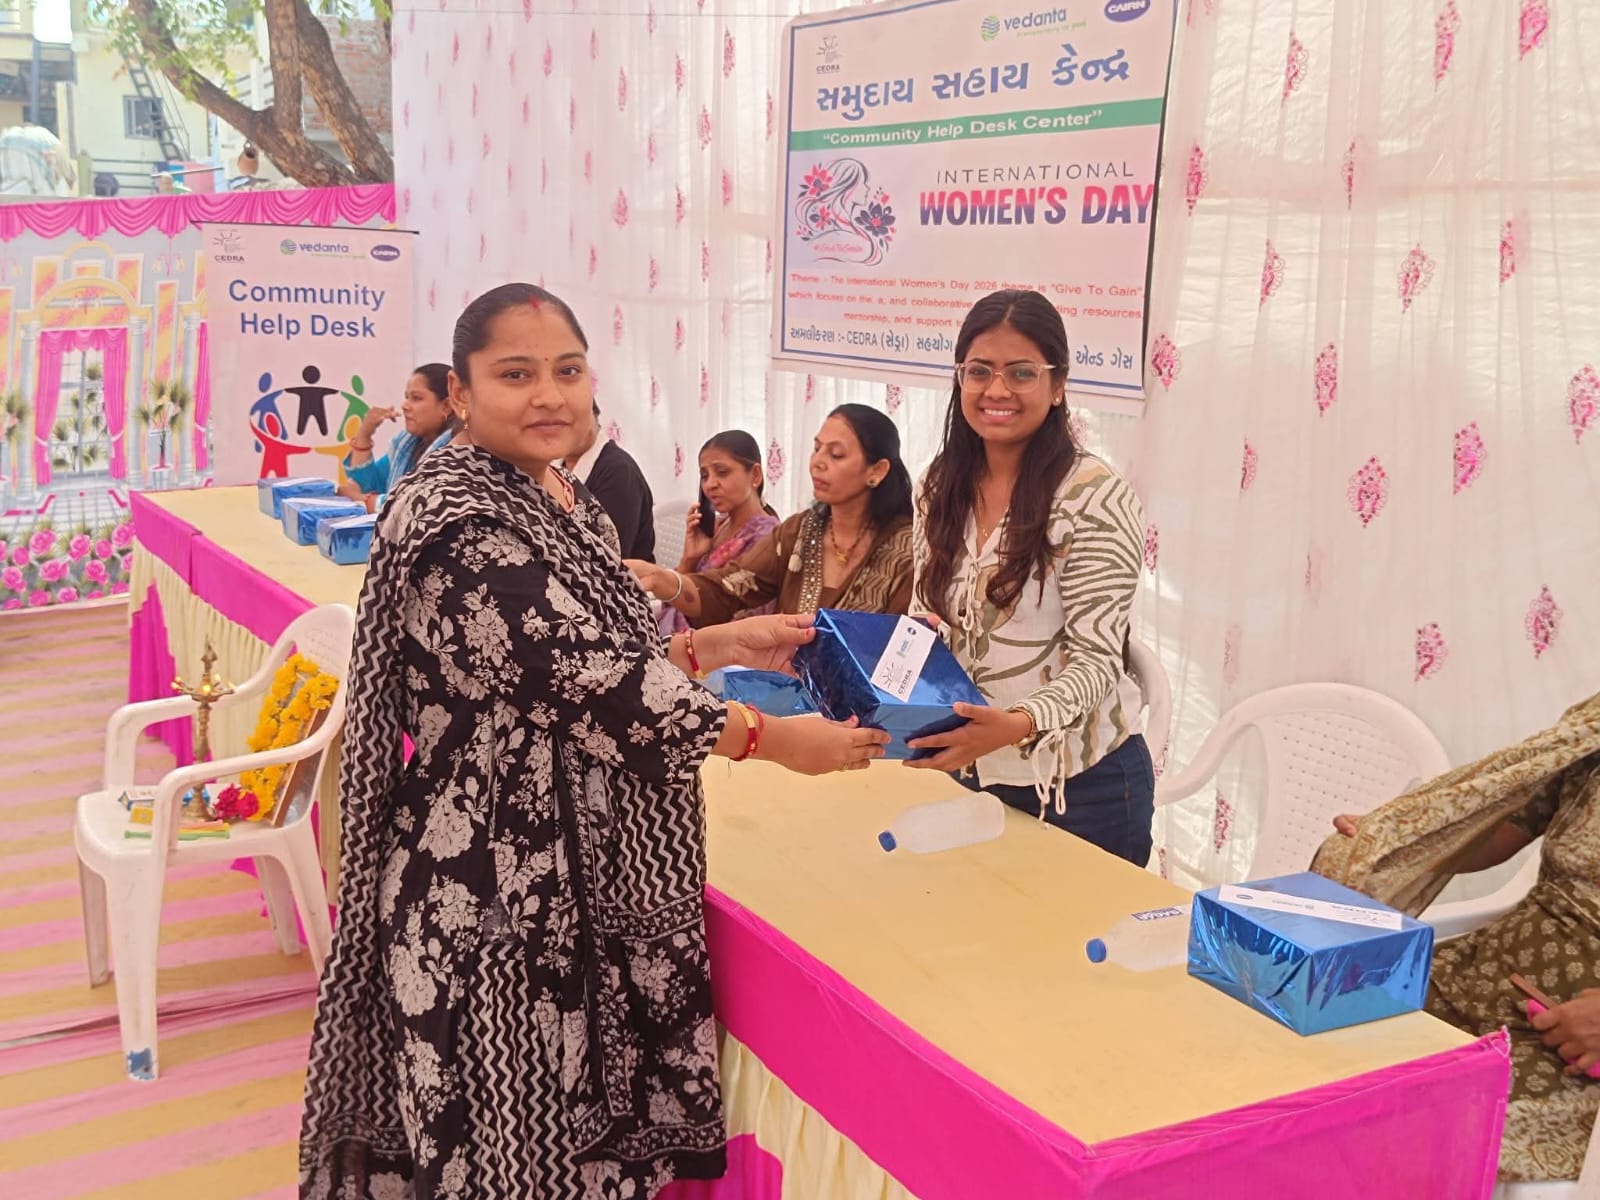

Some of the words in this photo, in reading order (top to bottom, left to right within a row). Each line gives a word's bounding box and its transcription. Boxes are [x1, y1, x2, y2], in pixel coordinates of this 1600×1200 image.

[1108, 0, 1146, 14] CAIRN
[1004, 8, 1067, 31] vedanta
[816, 64, 840, 73] CEDRA
[816, 78, 914, 121] સમુદાય
[931, 62, 1029, 100] સહાય
[1051, 43, 1130, 86] કેન્દ્ર
[927, 124, 964, 138] Help
[970, 117, 1017, 134] Desk
[937, 161, 1134, 185] INTERNATIONAL
[1081, 183, 1154, 225] DAY
[300, 242, 349, 253] vedanta
[229, 279, 385, 311] Community
[847, 276, 896, 287] International
[950, 280, 969, 291] Day
[1038, 284, 1046, 292] is
[1088, 285, 1103, 295] To
[788, 291, 812, 300] which
[889, 296, 907, 305] and
[911, 298, 972, 310] collaborative
[1082, 303, 1142, 318] resources
[241, 312, 300, 339] Help
[311, 315, 376, 337] Desk
[894, 316, 911, 325] and
[916, 317, 952, 328] support
[846, 330, 878, 347] CEDRA
